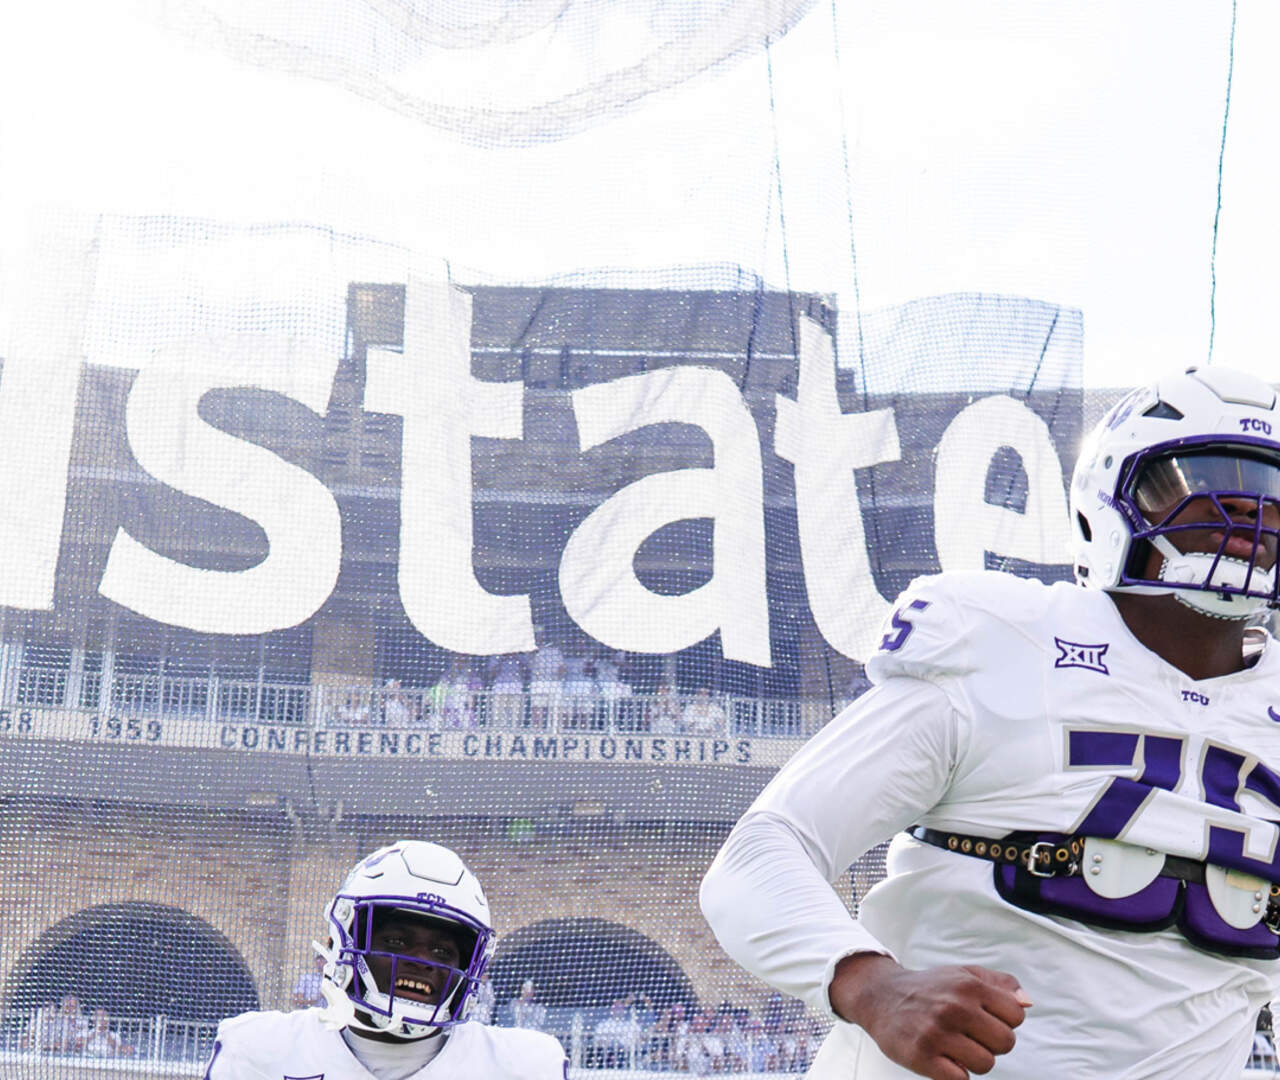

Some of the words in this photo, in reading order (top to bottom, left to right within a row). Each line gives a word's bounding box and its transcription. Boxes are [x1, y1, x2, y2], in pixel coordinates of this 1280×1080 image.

[1239, 418, 1272, 435] TCU
[879, 600, 929, 652] 5
[1181, 690, 1210, 706] TCU
[91, 714, 162, 742] 1959
[219, 725, 442, 757] CONFERENCE
[463, 734, 754, 764] CHAMPIONSHIPS
